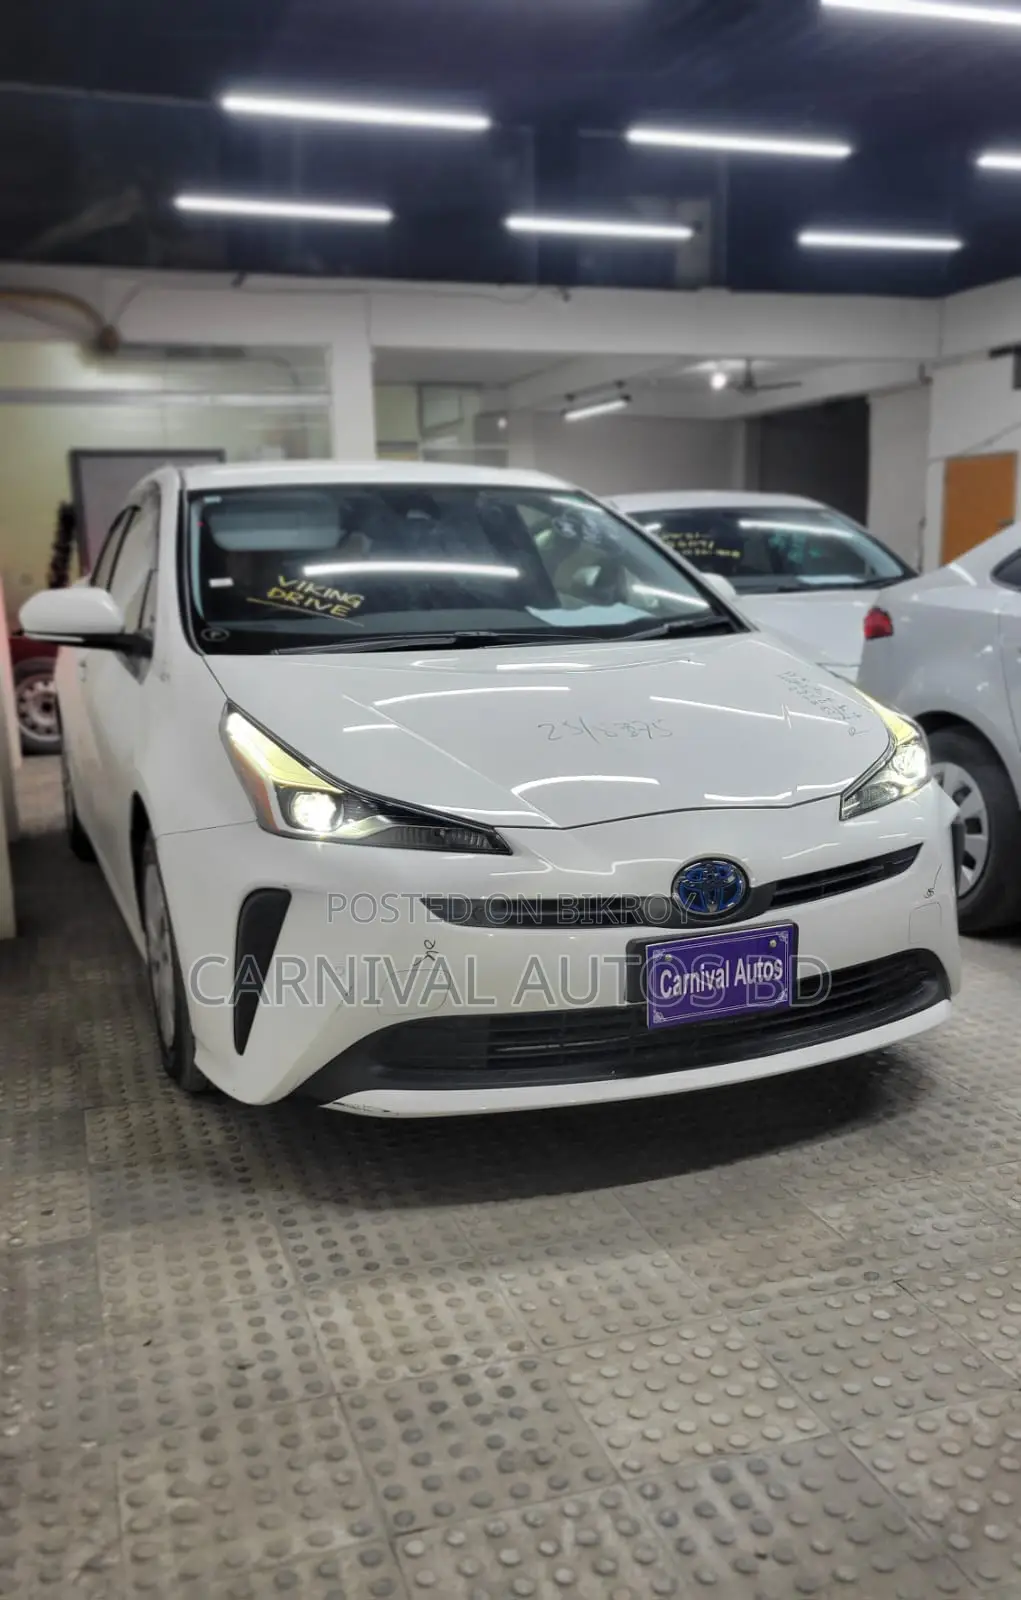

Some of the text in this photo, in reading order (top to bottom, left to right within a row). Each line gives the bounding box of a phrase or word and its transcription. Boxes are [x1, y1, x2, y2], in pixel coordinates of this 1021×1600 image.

[266, 587, 351, 617] DRIVE
[278, 575, 364, 608] VIKING
[659, 954, 784, 1000] Carnival Autos
